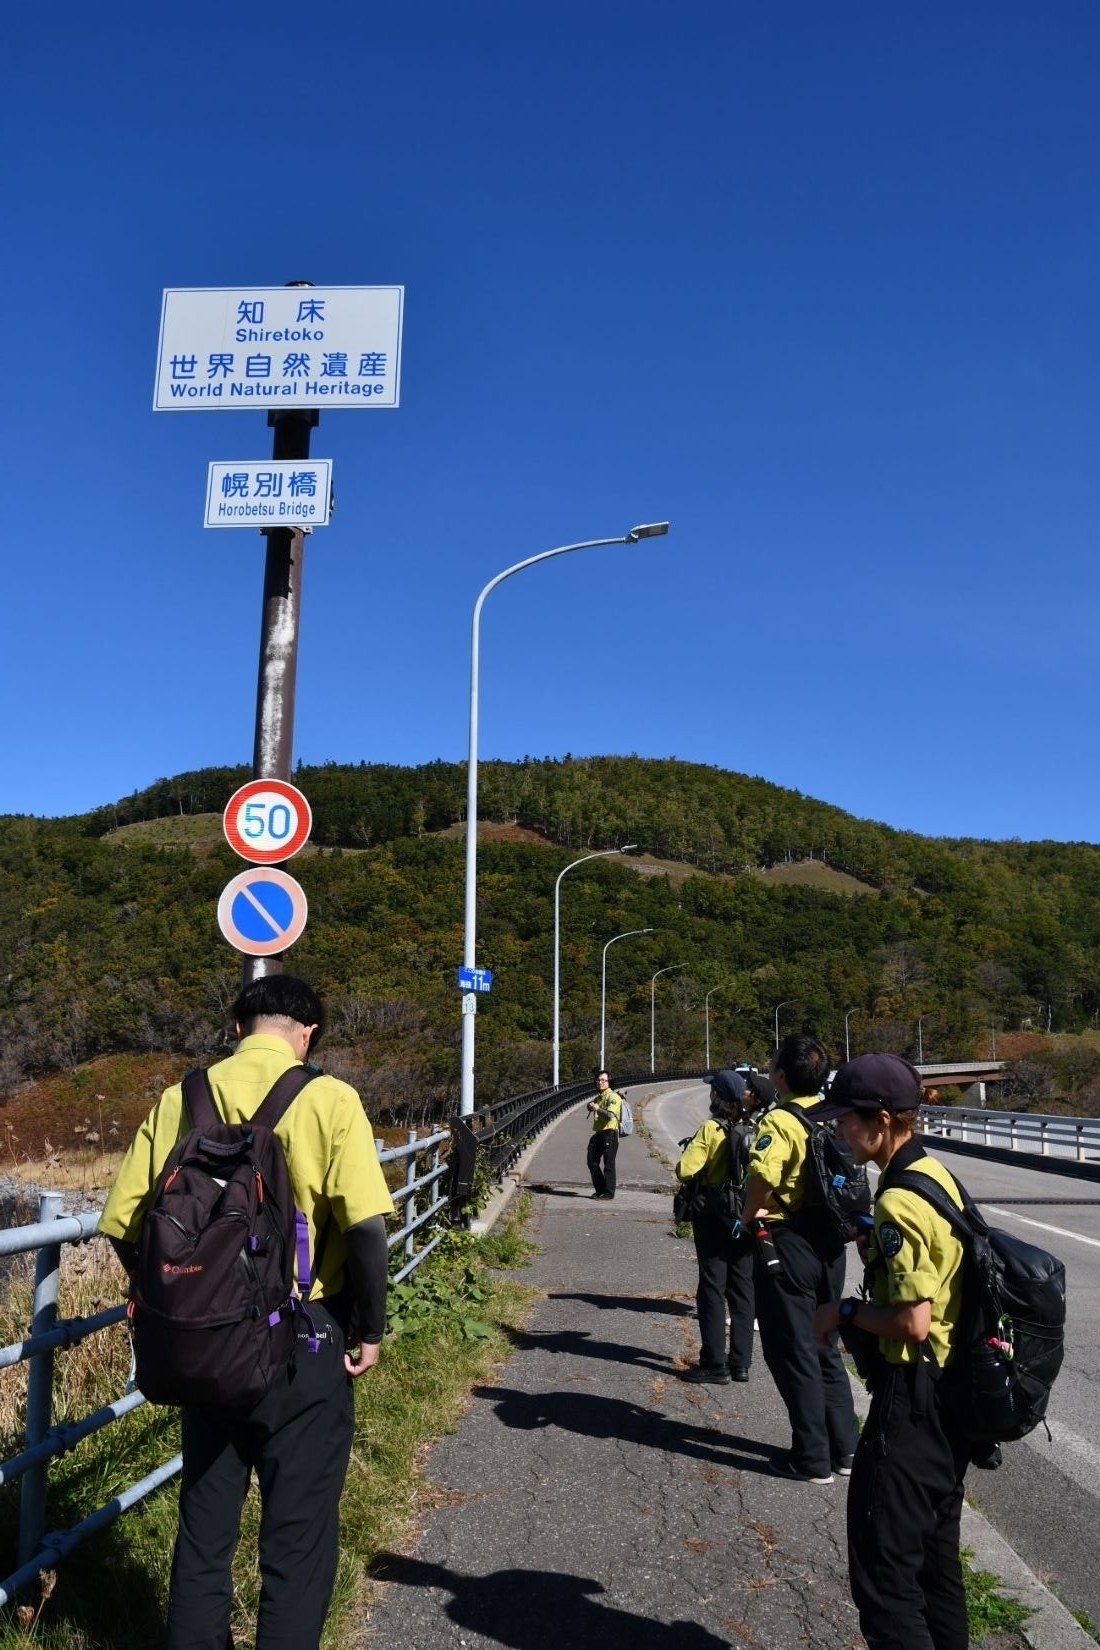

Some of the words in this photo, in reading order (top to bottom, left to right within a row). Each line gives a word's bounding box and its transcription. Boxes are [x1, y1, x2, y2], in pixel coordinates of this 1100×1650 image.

[237, 299, 326, 324] 知床
[236, 328, 324, 343] Shiretoko
[170, 352, 387, 380] 世界自然遺産
[170, 383, 223, 398] World
[230, 382, 297, 396] Natural
[305, 381, 384, 397] Heritage
[221, 471, 318, 498] 幌別橋
[218, 502, 275, 516] Horobetsu
[279, 501, 316, 518] Bridge
[244, 803, 291, 839] 50
